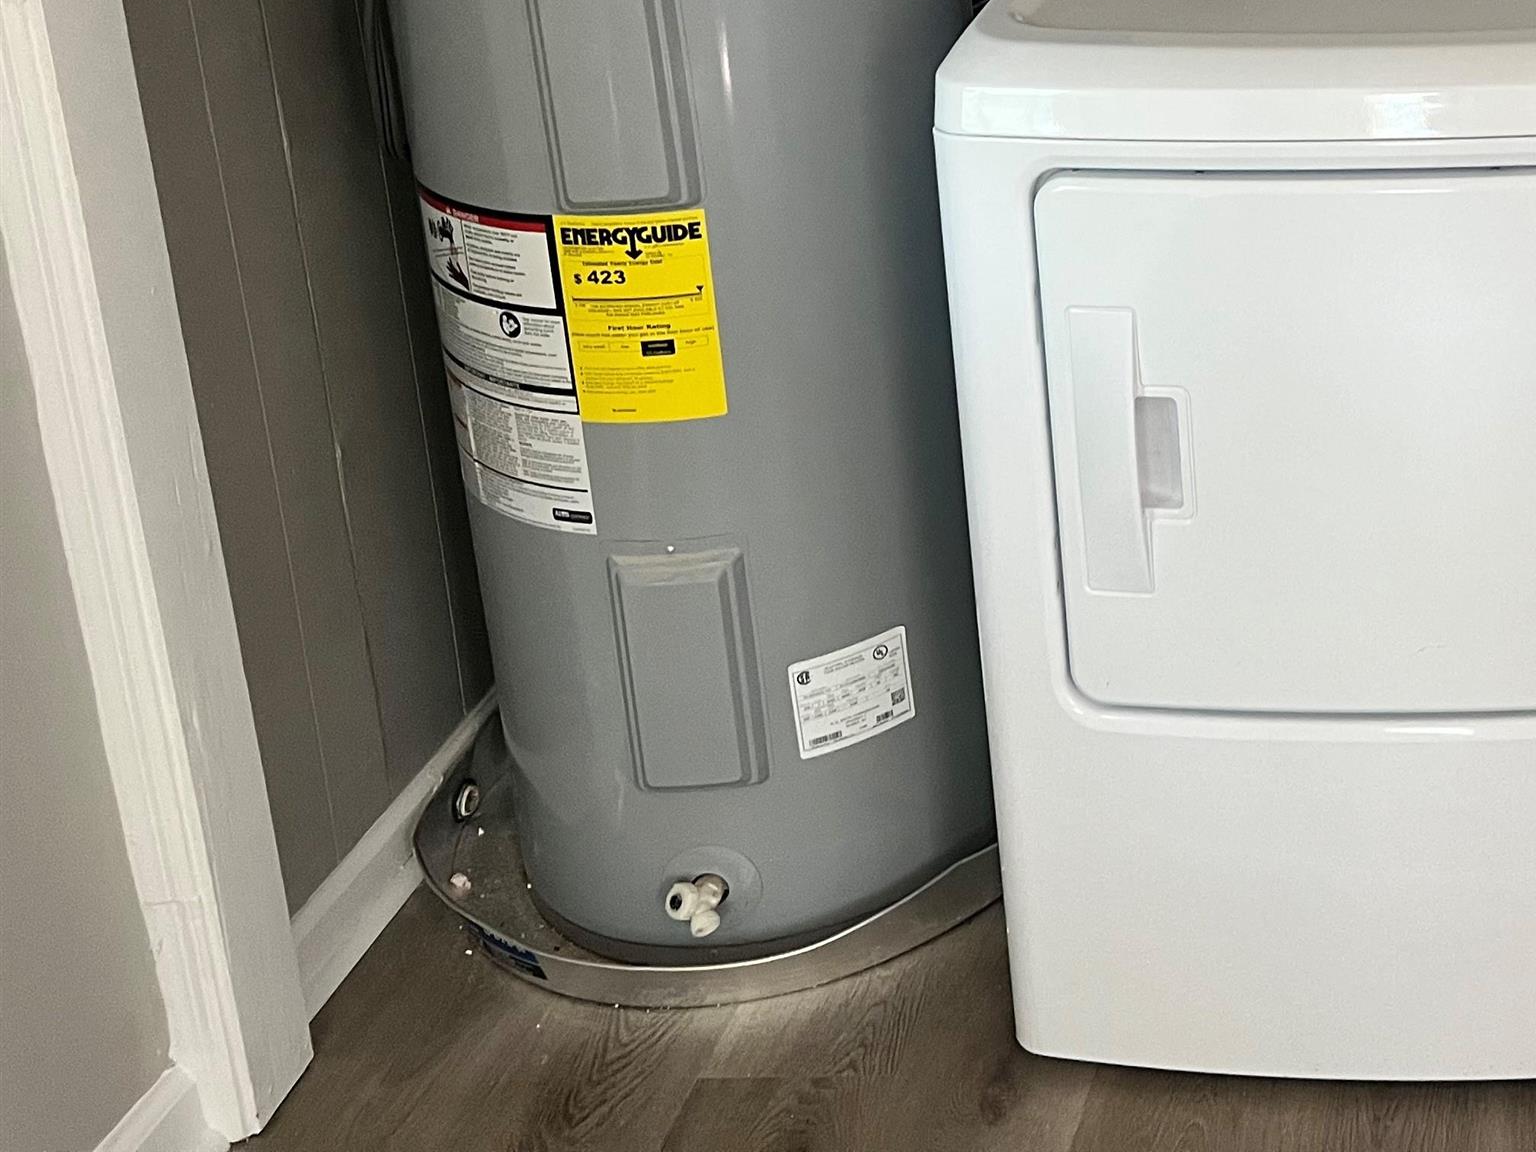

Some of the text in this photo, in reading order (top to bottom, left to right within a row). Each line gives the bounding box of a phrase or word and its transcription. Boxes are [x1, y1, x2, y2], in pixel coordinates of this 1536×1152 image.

[560, 221, 702, 246] ENERGYGUIDE
[573, 269, 626, 285] $ 423
